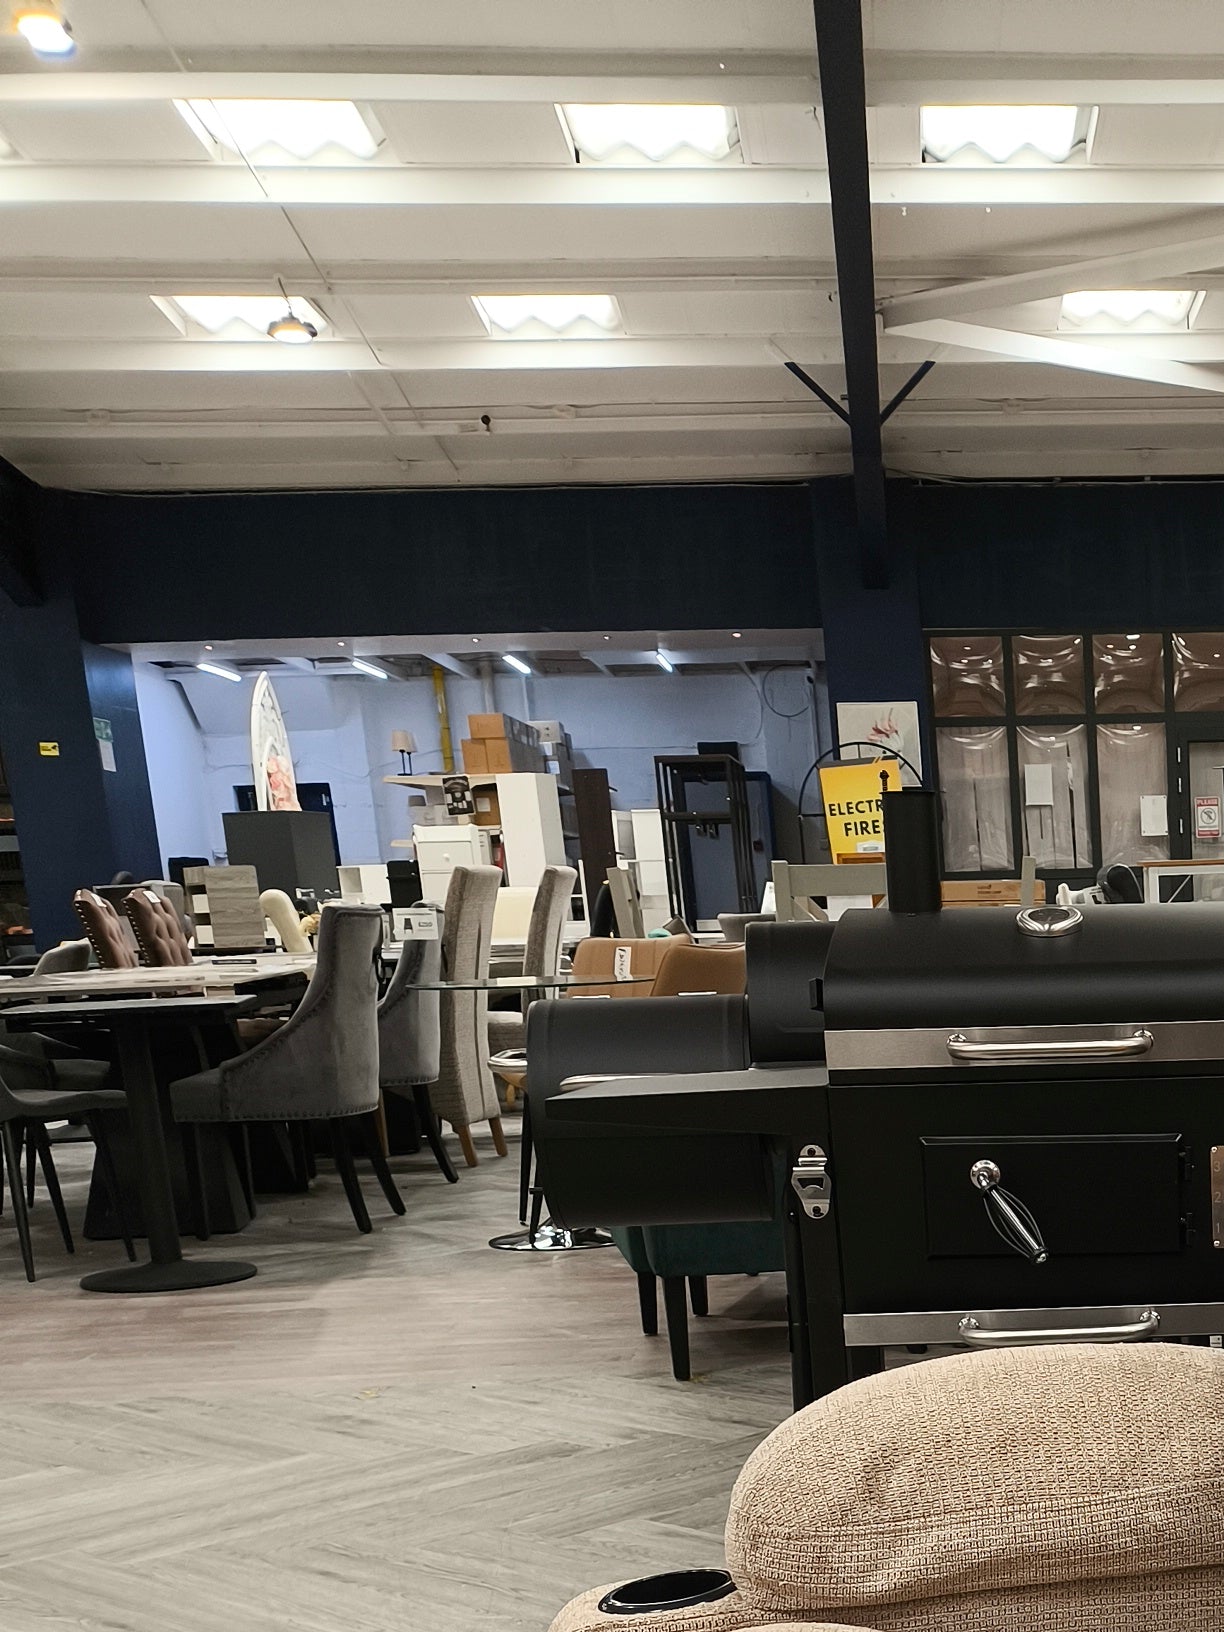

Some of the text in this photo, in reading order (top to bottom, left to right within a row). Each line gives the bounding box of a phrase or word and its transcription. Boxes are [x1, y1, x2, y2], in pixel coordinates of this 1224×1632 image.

[828, 799, 883, 816] ELECTR
[843, 819, 883, 837] FIRE
[1213, 1160, 1221, 1172] 3
[1214, 1191, 1221, 1203] 2
